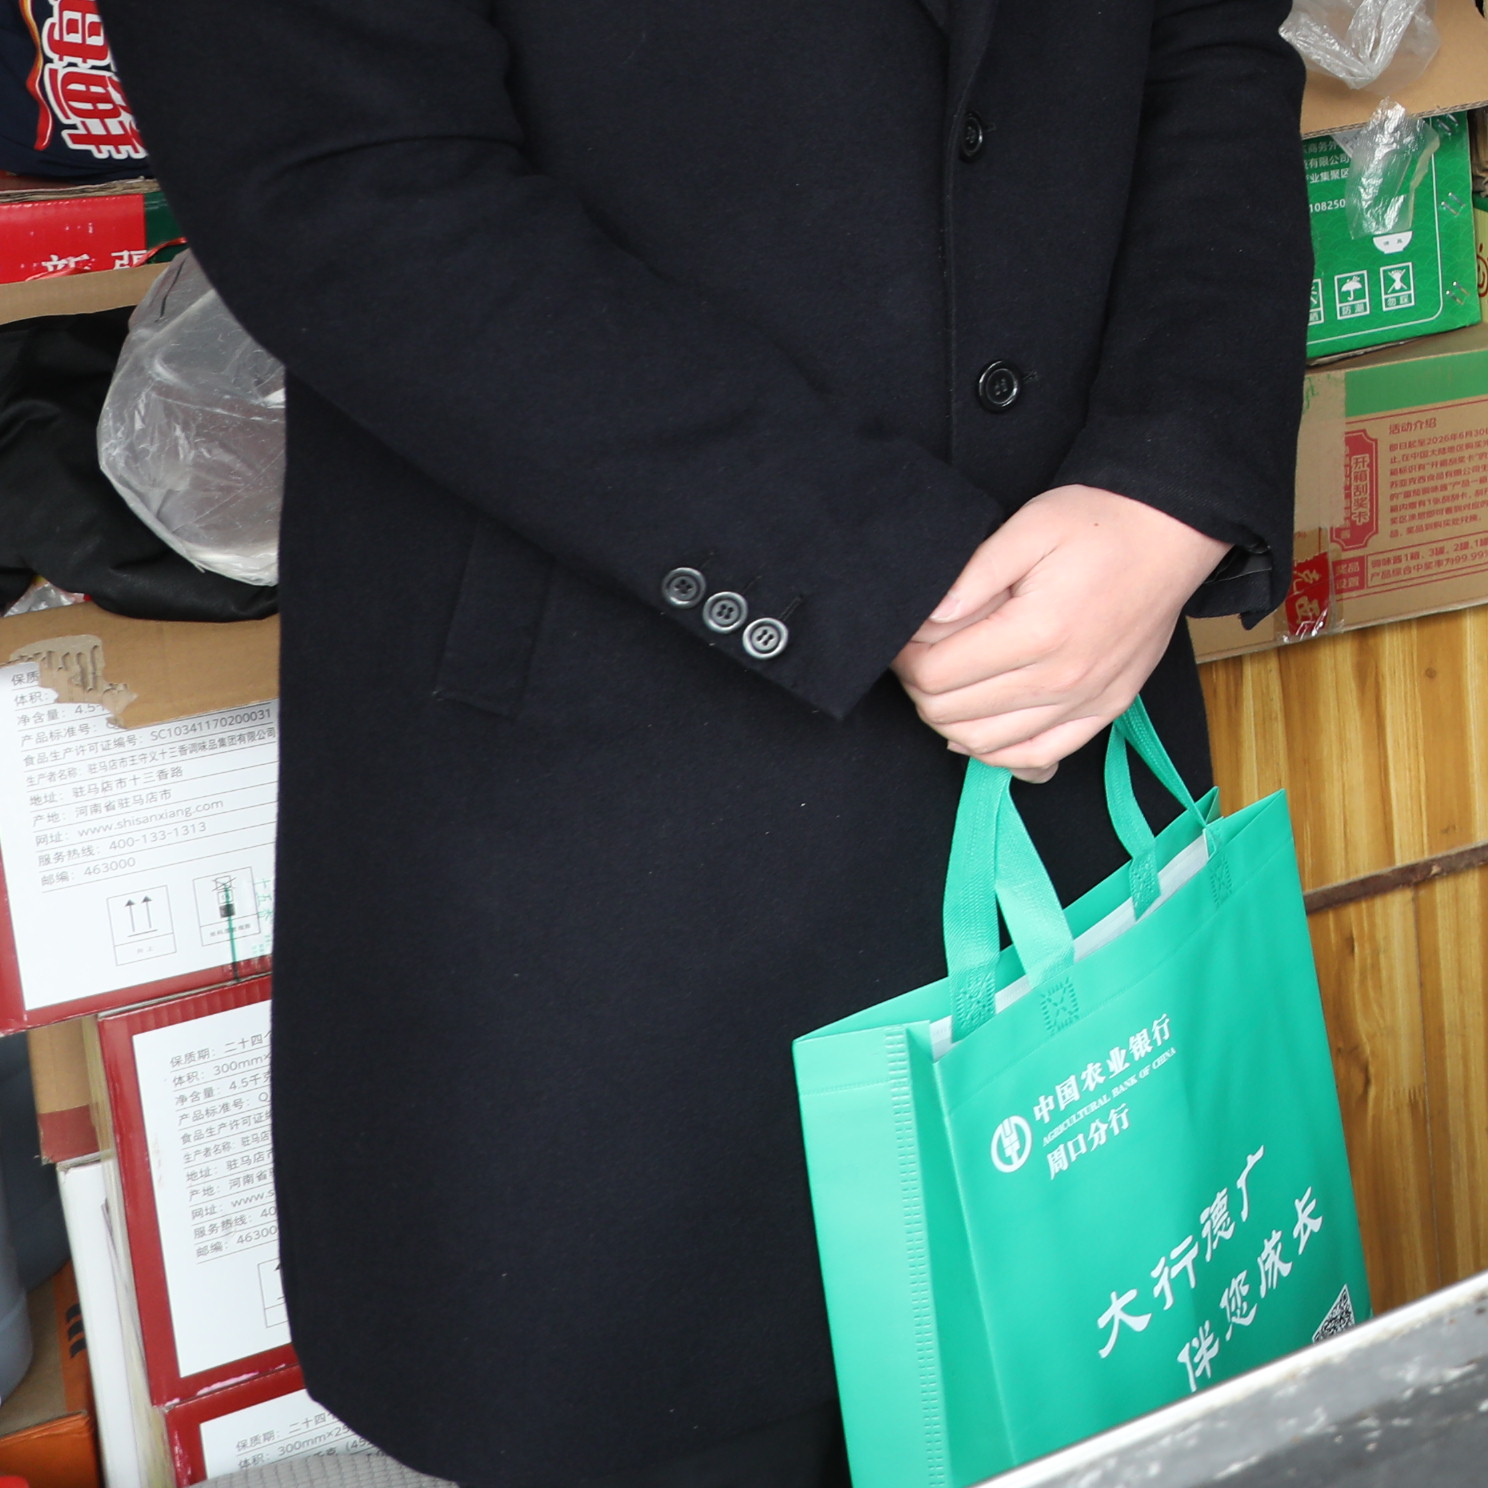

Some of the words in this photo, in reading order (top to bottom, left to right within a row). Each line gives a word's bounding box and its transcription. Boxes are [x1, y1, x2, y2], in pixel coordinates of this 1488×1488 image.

[1305, 167, 1351, 185] 业集聚区
[1389, 417, 1438, 436] 活动介绍
[1351, 453, 1371, 527] 开箱刮奖卡
[14, 690, 50, 707] 体积：
[17, 707, 66, 726] 净含量：
[74, 702, 101, 715] 4.5
[21, 722, 98, 748] 产品标准号：
[150, 708, 272, 742] SC10341170200031
[29, 791, 64, 806] 地址：
[72, 765, 184, 799] 驻马店市十三香路
[32, 811, 67, 828] 产地：
[74, 787, 173, 819] 河南省驻马店市
[35, 830, 70, 848] 网址：
[78, 797, 224, 838] www.shisanxiang.com
[38, 844, 102, 868] 服务热线：
[108, 821, 207, 852] 400-133-1313
[41, 869, 75, 888] 邮编：
[83, 856, 137, 878] 463000
[170, 1046, 217, 1069] 保质期：
[1032, 1012, 1171, 1125] 中国农业银行
[172, 1070, 205, 1088] 体积：
[1042, 1093, 1112, 1148] AGRICULTURAL
[1111, 1073, 1139, 1099] BANK
[1139, 1064, 1152, 1080] OF
[1151, 1046, 1177, 1071] CHINA
[1046, 1102, 1131, 1181] 周口分行
[228, 1168, 274, 1191] 河南省
[1096, 1143, 1268, 1361] 大行德广
[1176, 1184, 1325, 1394] 伴您成长
